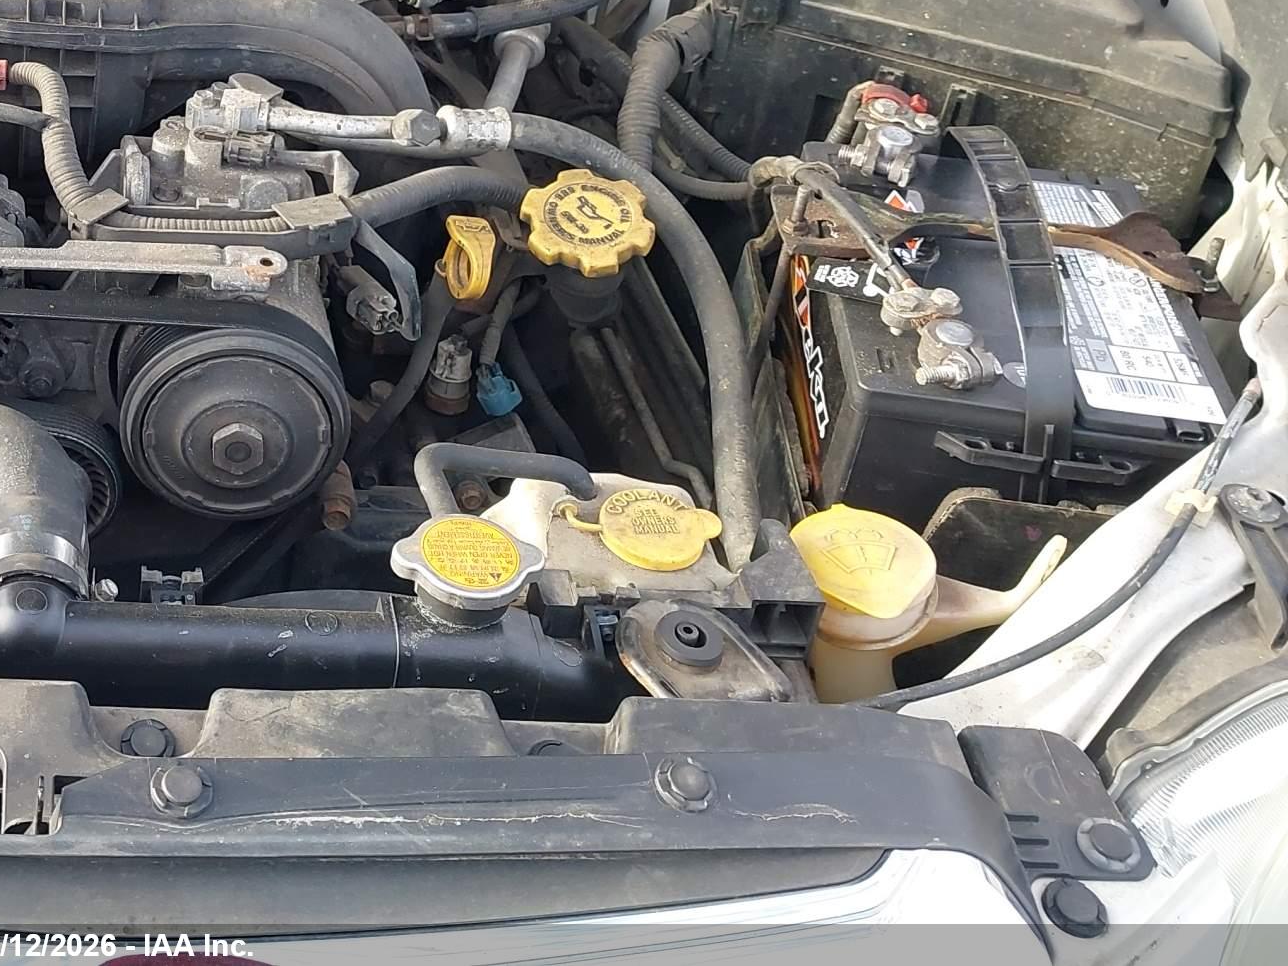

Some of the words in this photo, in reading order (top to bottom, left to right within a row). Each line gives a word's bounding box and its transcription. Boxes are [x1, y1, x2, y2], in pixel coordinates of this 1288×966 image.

[581, 184, 626, 207] ENGINE
[620, 208, 632, 224] OIL
[578, 229, 625, 245] MANUAL
[606, 489, 689, 515] COOLANT
[633, 507, 657, 516] SEE
[634, 524, 680, 535] MANUAL
